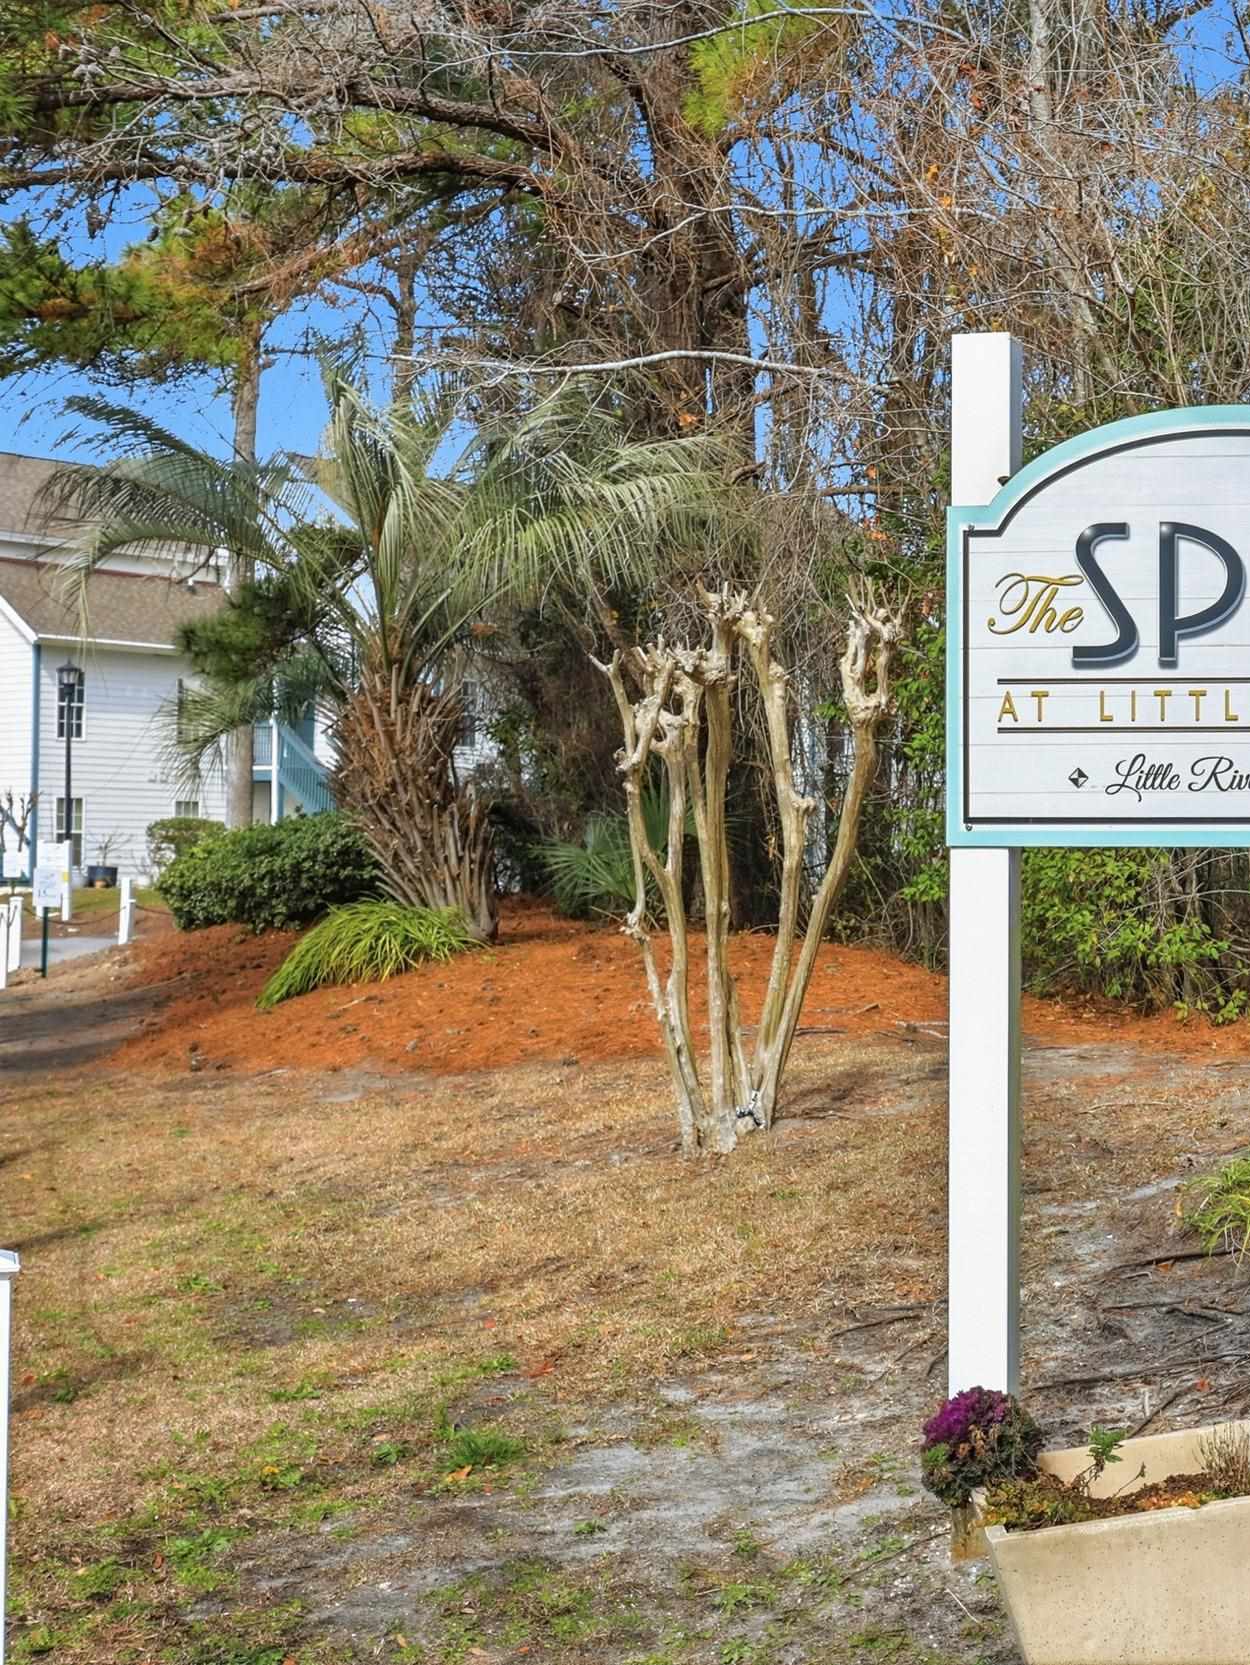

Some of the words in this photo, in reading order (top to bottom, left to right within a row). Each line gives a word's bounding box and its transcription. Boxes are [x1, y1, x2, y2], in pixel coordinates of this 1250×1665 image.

[988, 572, 1084, 635] The
[998, 690, 1051, 723] AT
[1105, 753, 1181, 802] Little
